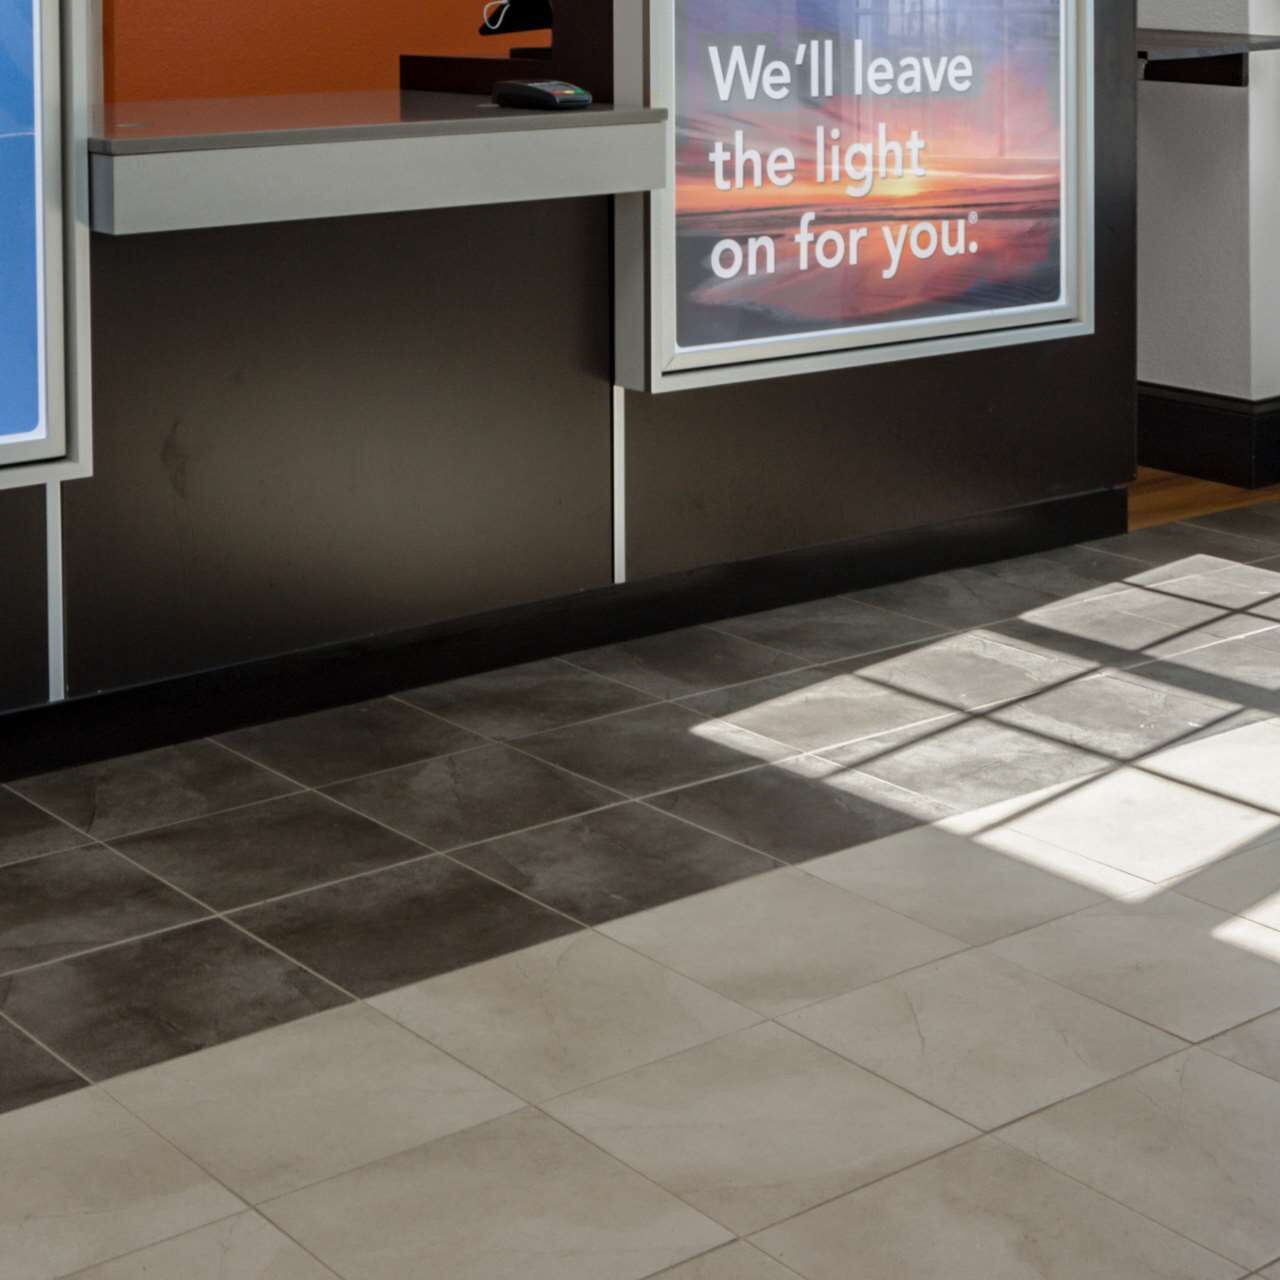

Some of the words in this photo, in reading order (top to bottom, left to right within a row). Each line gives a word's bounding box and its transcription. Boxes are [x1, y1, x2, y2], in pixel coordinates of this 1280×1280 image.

[708, 39, 833, 101] We’ll
[854, 39, 973, 95] leave
[708, 130, 795, 190] the
[816, 122, 927, 197] light
[710, 234, 775, 279] on
[794, 211, 867, 271] for
